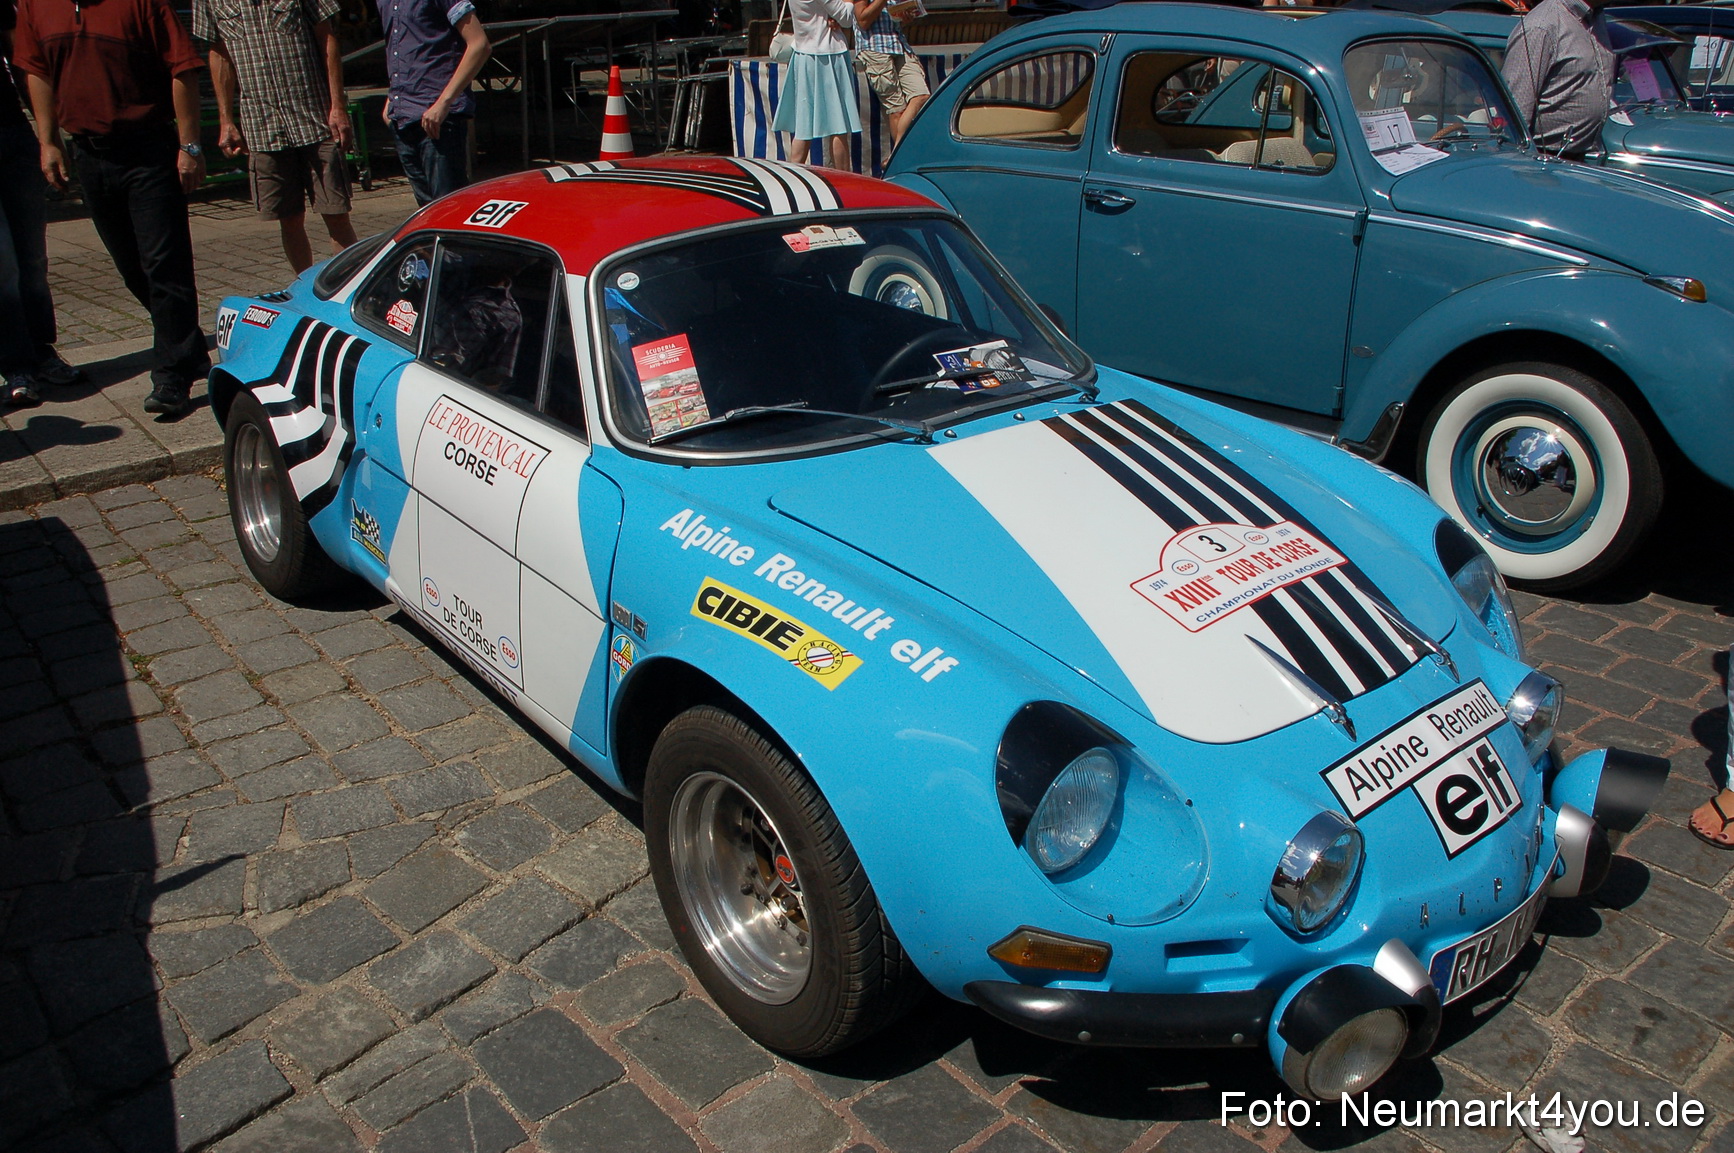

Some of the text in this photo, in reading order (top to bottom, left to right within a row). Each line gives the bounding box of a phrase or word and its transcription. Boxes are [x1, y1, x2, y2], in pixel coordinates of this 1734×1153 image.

[470, 202, 527, 225] elf
[219, 314, 237, 346] elf
[645, 343, 676, 356] SCUDERIA
[427, 403, 446, 434] LE
[444, 441, 498, 486] CORSE
[1198, 535, 1227, 553] 3
[1248, 533, 1264, 543] Esso
[1276, 528, 1291, 537] 1974
[1176, 562, 1194, 572] Esso
[1216, 558, 1265, 585] TOUR
[1250, 551, 1282, 570] DE
[1269, 538, 1320, 564] CORSE
[425, 583, 438, 600] Esso
[659, 508, 960, 683] Alpine Renault elf
[1149, 579, 1169, 591] 1974
[1196, 557, 1334, 623] CHAMPIONAT DU MONDE
[453, 594, 483, 630] TOUR
[443, 606, 498, 662] DE CORSE
[502, 642, 516, 661] Esso
[800, 658, 821, 672] TEAM
[810, 641, 841, 665] RACING
[1344, 692, 1499, 801] Alpine Renault
[1435, 743, 1513, 836] elf
[1447, 929, 1499, 996] RH
